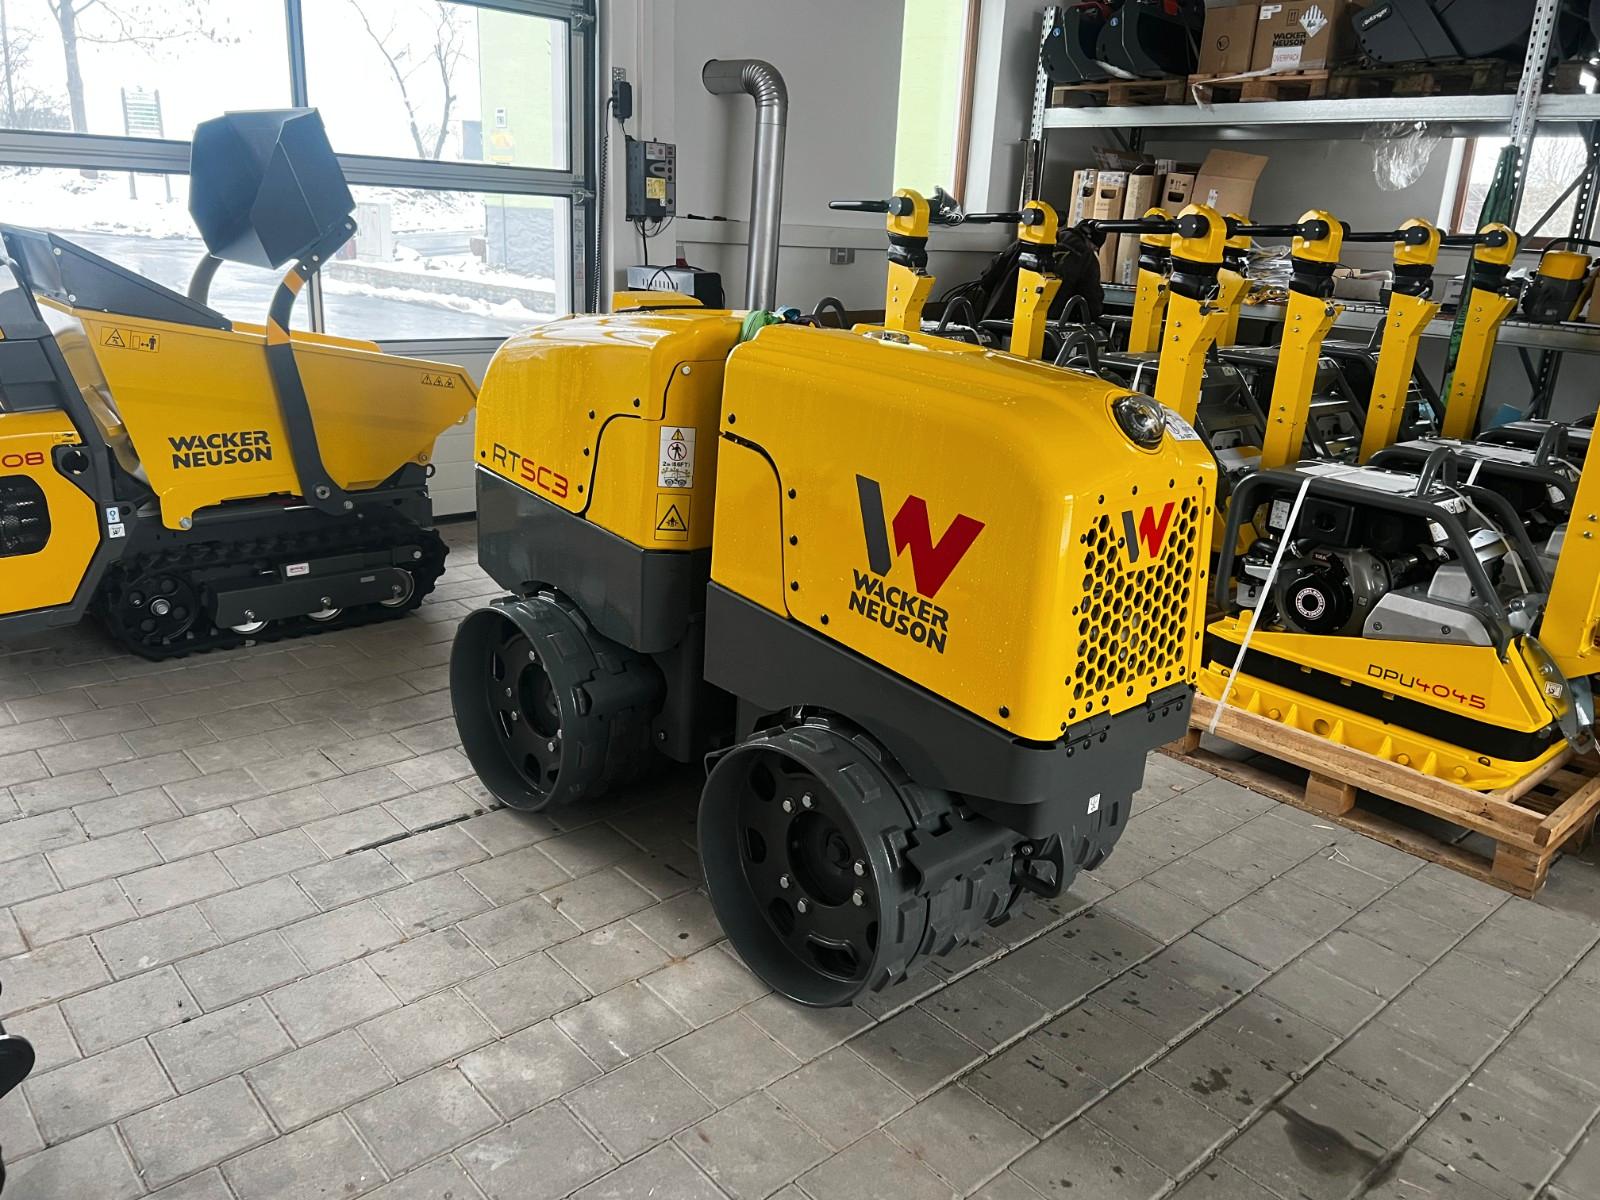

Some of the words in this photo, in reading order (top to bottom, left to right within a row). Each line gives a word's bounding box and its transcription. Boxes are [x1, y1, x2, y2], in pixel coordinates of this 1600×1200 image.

[1272, 39, 1307, 47] NEUSON
[1273, 32, 1307, 40] WACKER
[168, 430, 271, 452] WACKER
[172, 446, 272, 469] NEUSON
[492, 442, 568, 499] RTSC3
[853, 568, 949, 632] WACKER
[849, 591, 948, 654] NEUSON
[1367, 664, 1486, 710] DPU4045
